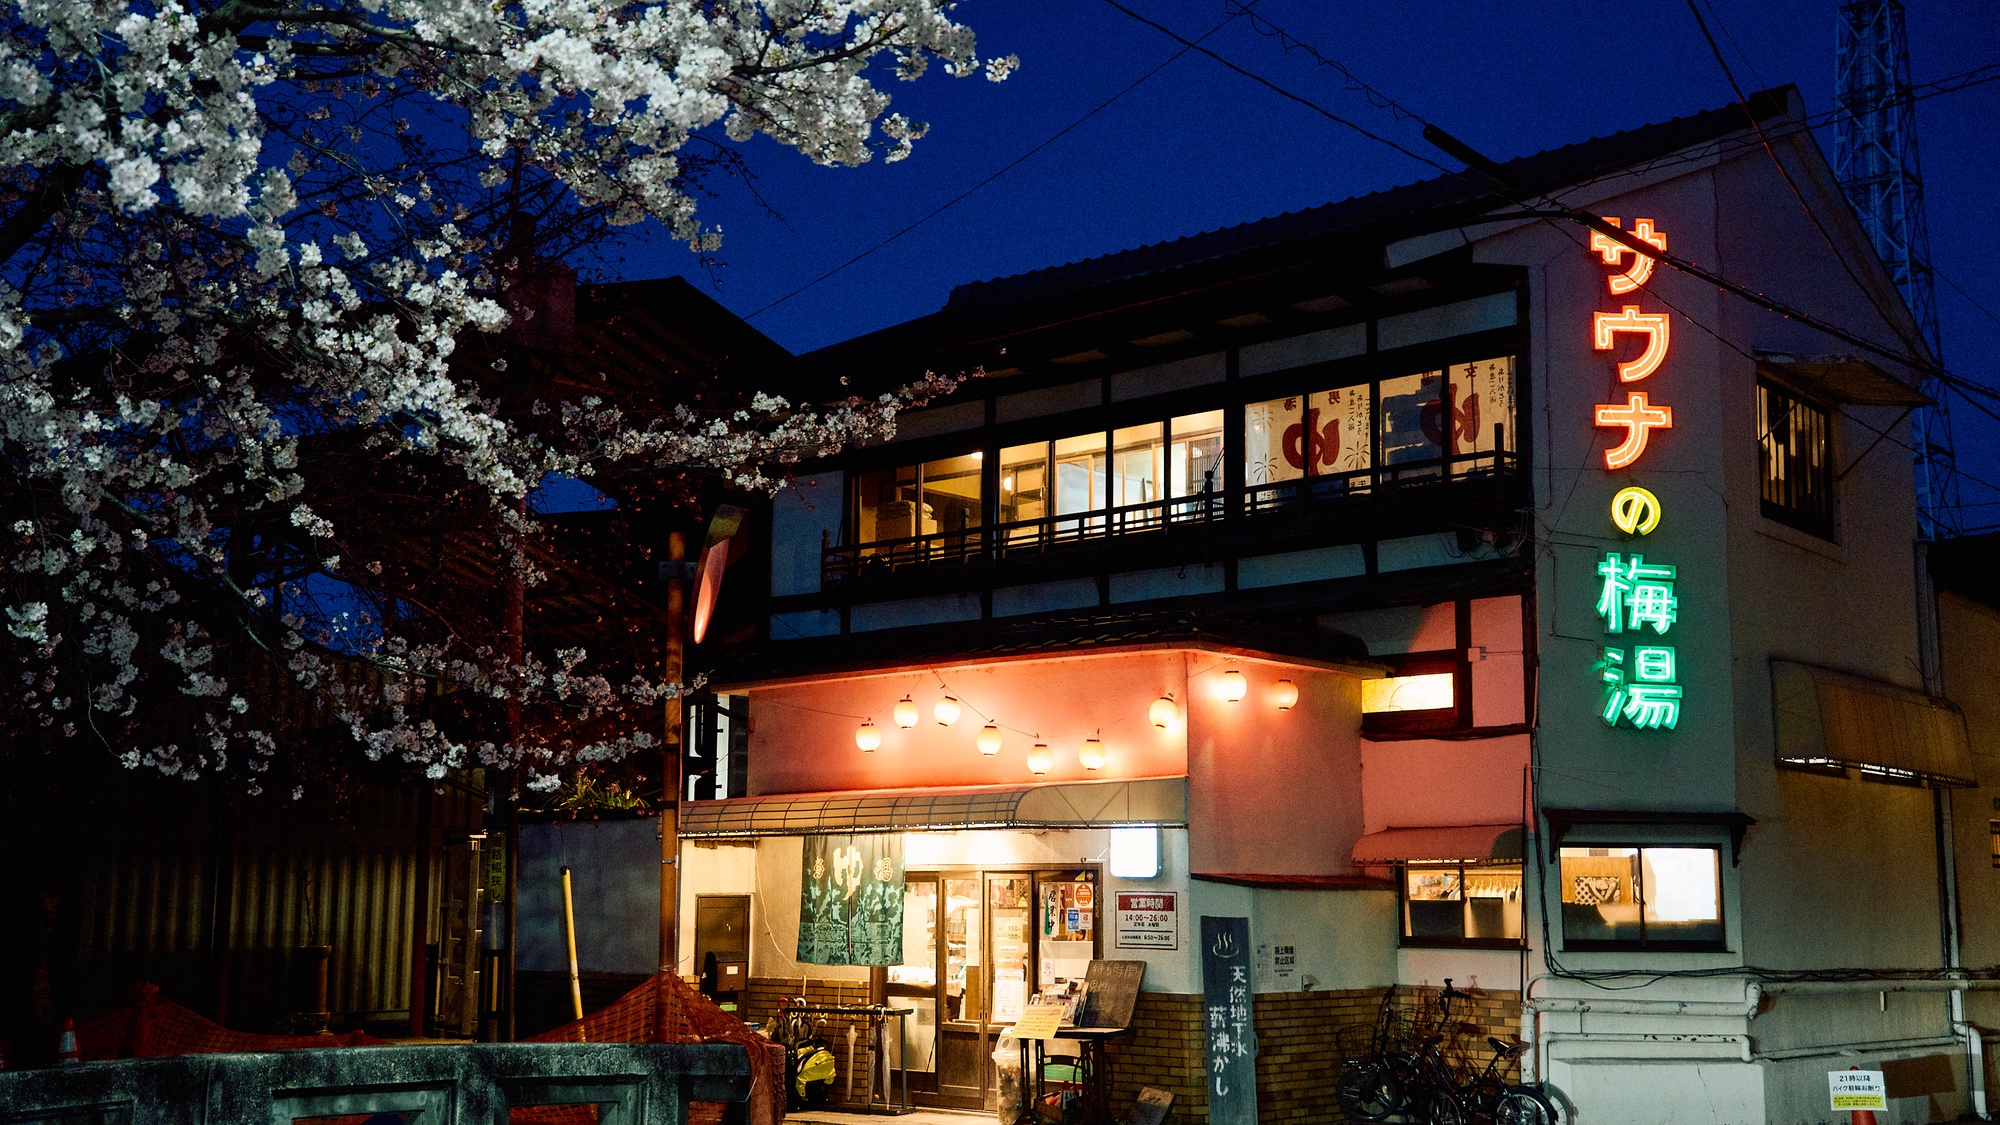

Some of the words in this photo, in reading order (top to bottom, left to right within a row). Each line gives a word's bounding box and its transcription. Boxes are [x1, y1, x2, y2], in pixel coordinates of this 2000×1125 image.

[1590, 216, 1683, 730] サウナの梅湯
[833, 844, 863, 900] ゆ
[1130, 897, 1164, 909] 営業時間
[1230, 965, 1248, 1057] 天然地下水
[1209, 1005, 1231, 1097] 薪沸かし
[1838, 1074, 1871, 1082] 21時以降
[1832, 1084, 1881, 1092] バイク駐輪お断り
